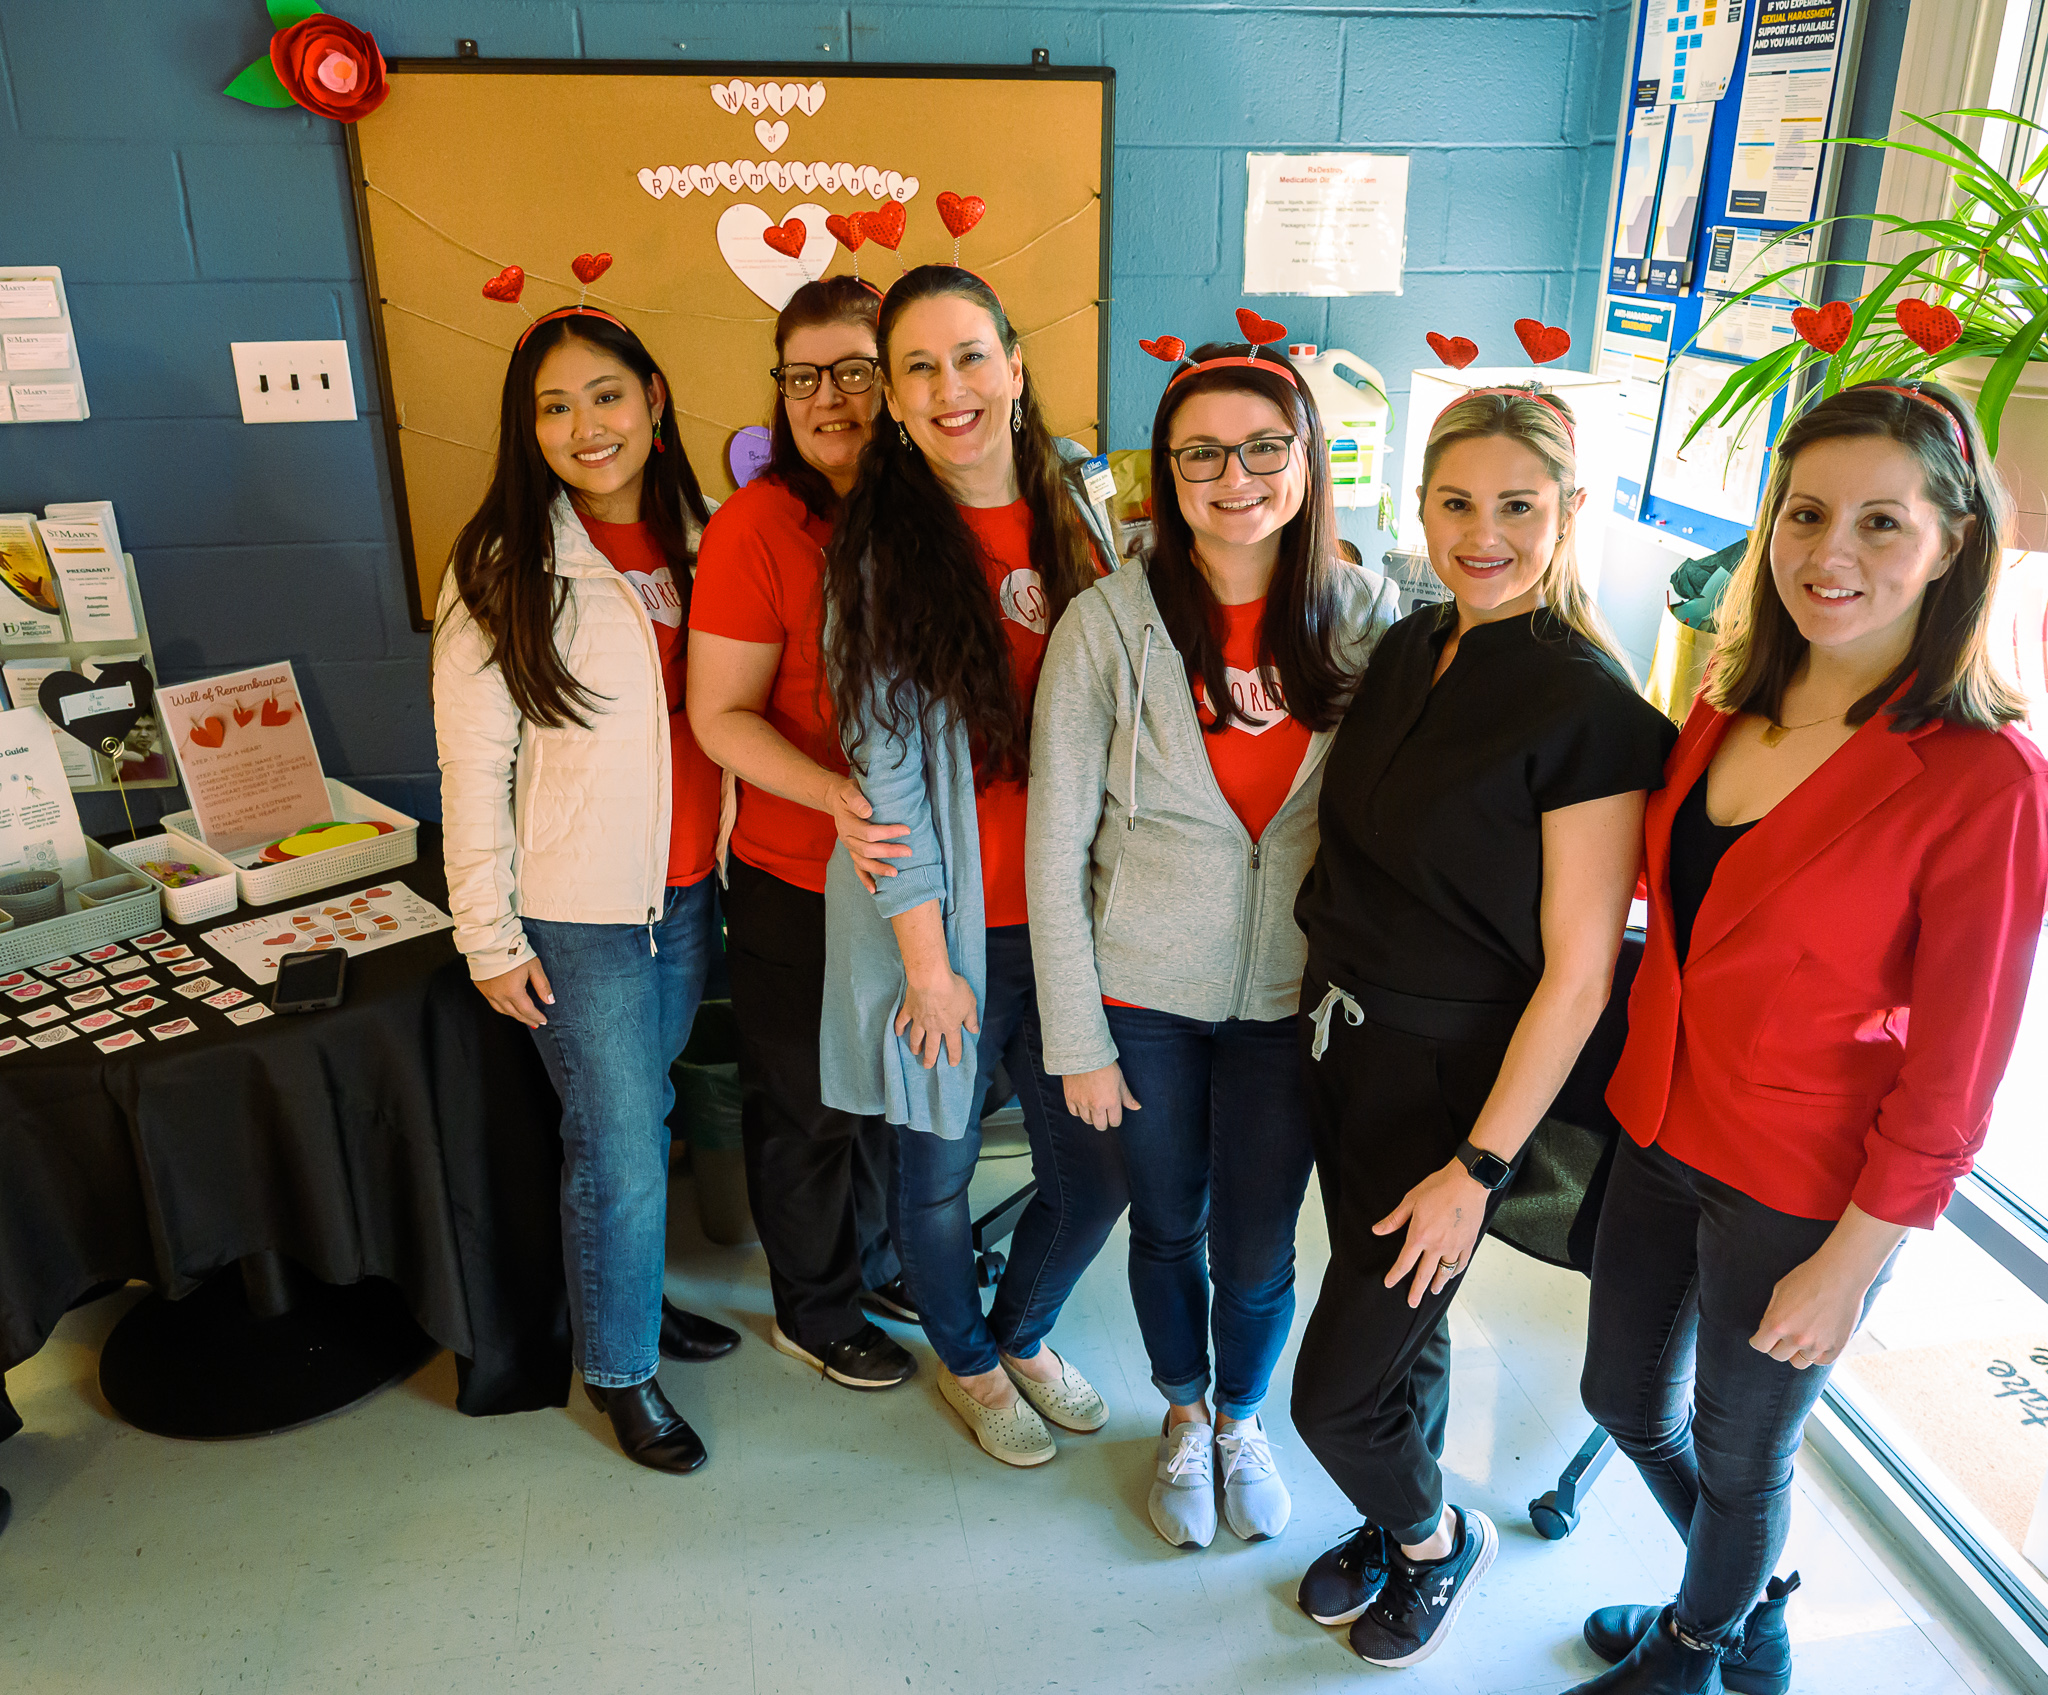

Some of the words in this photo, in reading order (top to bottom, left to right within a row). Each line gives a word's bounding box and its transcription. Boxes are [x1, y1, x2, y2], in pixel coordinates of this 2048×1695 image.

[1761, 12, 1786, 24] SEXUAL
[1788, 7, 1835, 22] HARASSMENT,
[1767, 2, 1774, 12] IF
[1776, 0, 1790, 10] YOU
[1758, 24, 1789, 37] SUPPORT
[1789, 24, 1796, 34] IS
[1796, 20, 1835, 33] AVAILABLE
[1754, 39, 1770, 49] AND
[1770, 38, 1784, 48] YOU
[1784, 36, 1804, 46] HAVE
[1804, 33, 1835, 45] OPTIONS
[722, 91, 811, 113] Wall
[767, 133, 776, 144] of
[652, 168, 905, 198] Remembrance
[655, 582, 681, 608] RE
[1013, 585, 1046, 623] GO
[170, 691, 200, 706] Wall
[202, 688, 214, 702] of
[214, 676, 287, 697] Remembrance
[5, 746, 29, 757] Guide
[192, 758, 208, 766] STEP
[216, 752, 232, 760] PICK
[240, 744, 262, 754] HEART
[196, 772, 212, 780] STEP
[254, 757, 272, 765] NAME
[206, 783, 227, 792] HEART
[291, 760, 313, 771] BATTLE
[219, 787, 241, 796] HEART
[208, 814, 225, 823] STEP
[234, 806, 254, 816] GRAB
[222, 817, 242, 827] HANG
[258, 807, 280, 817] HEART
